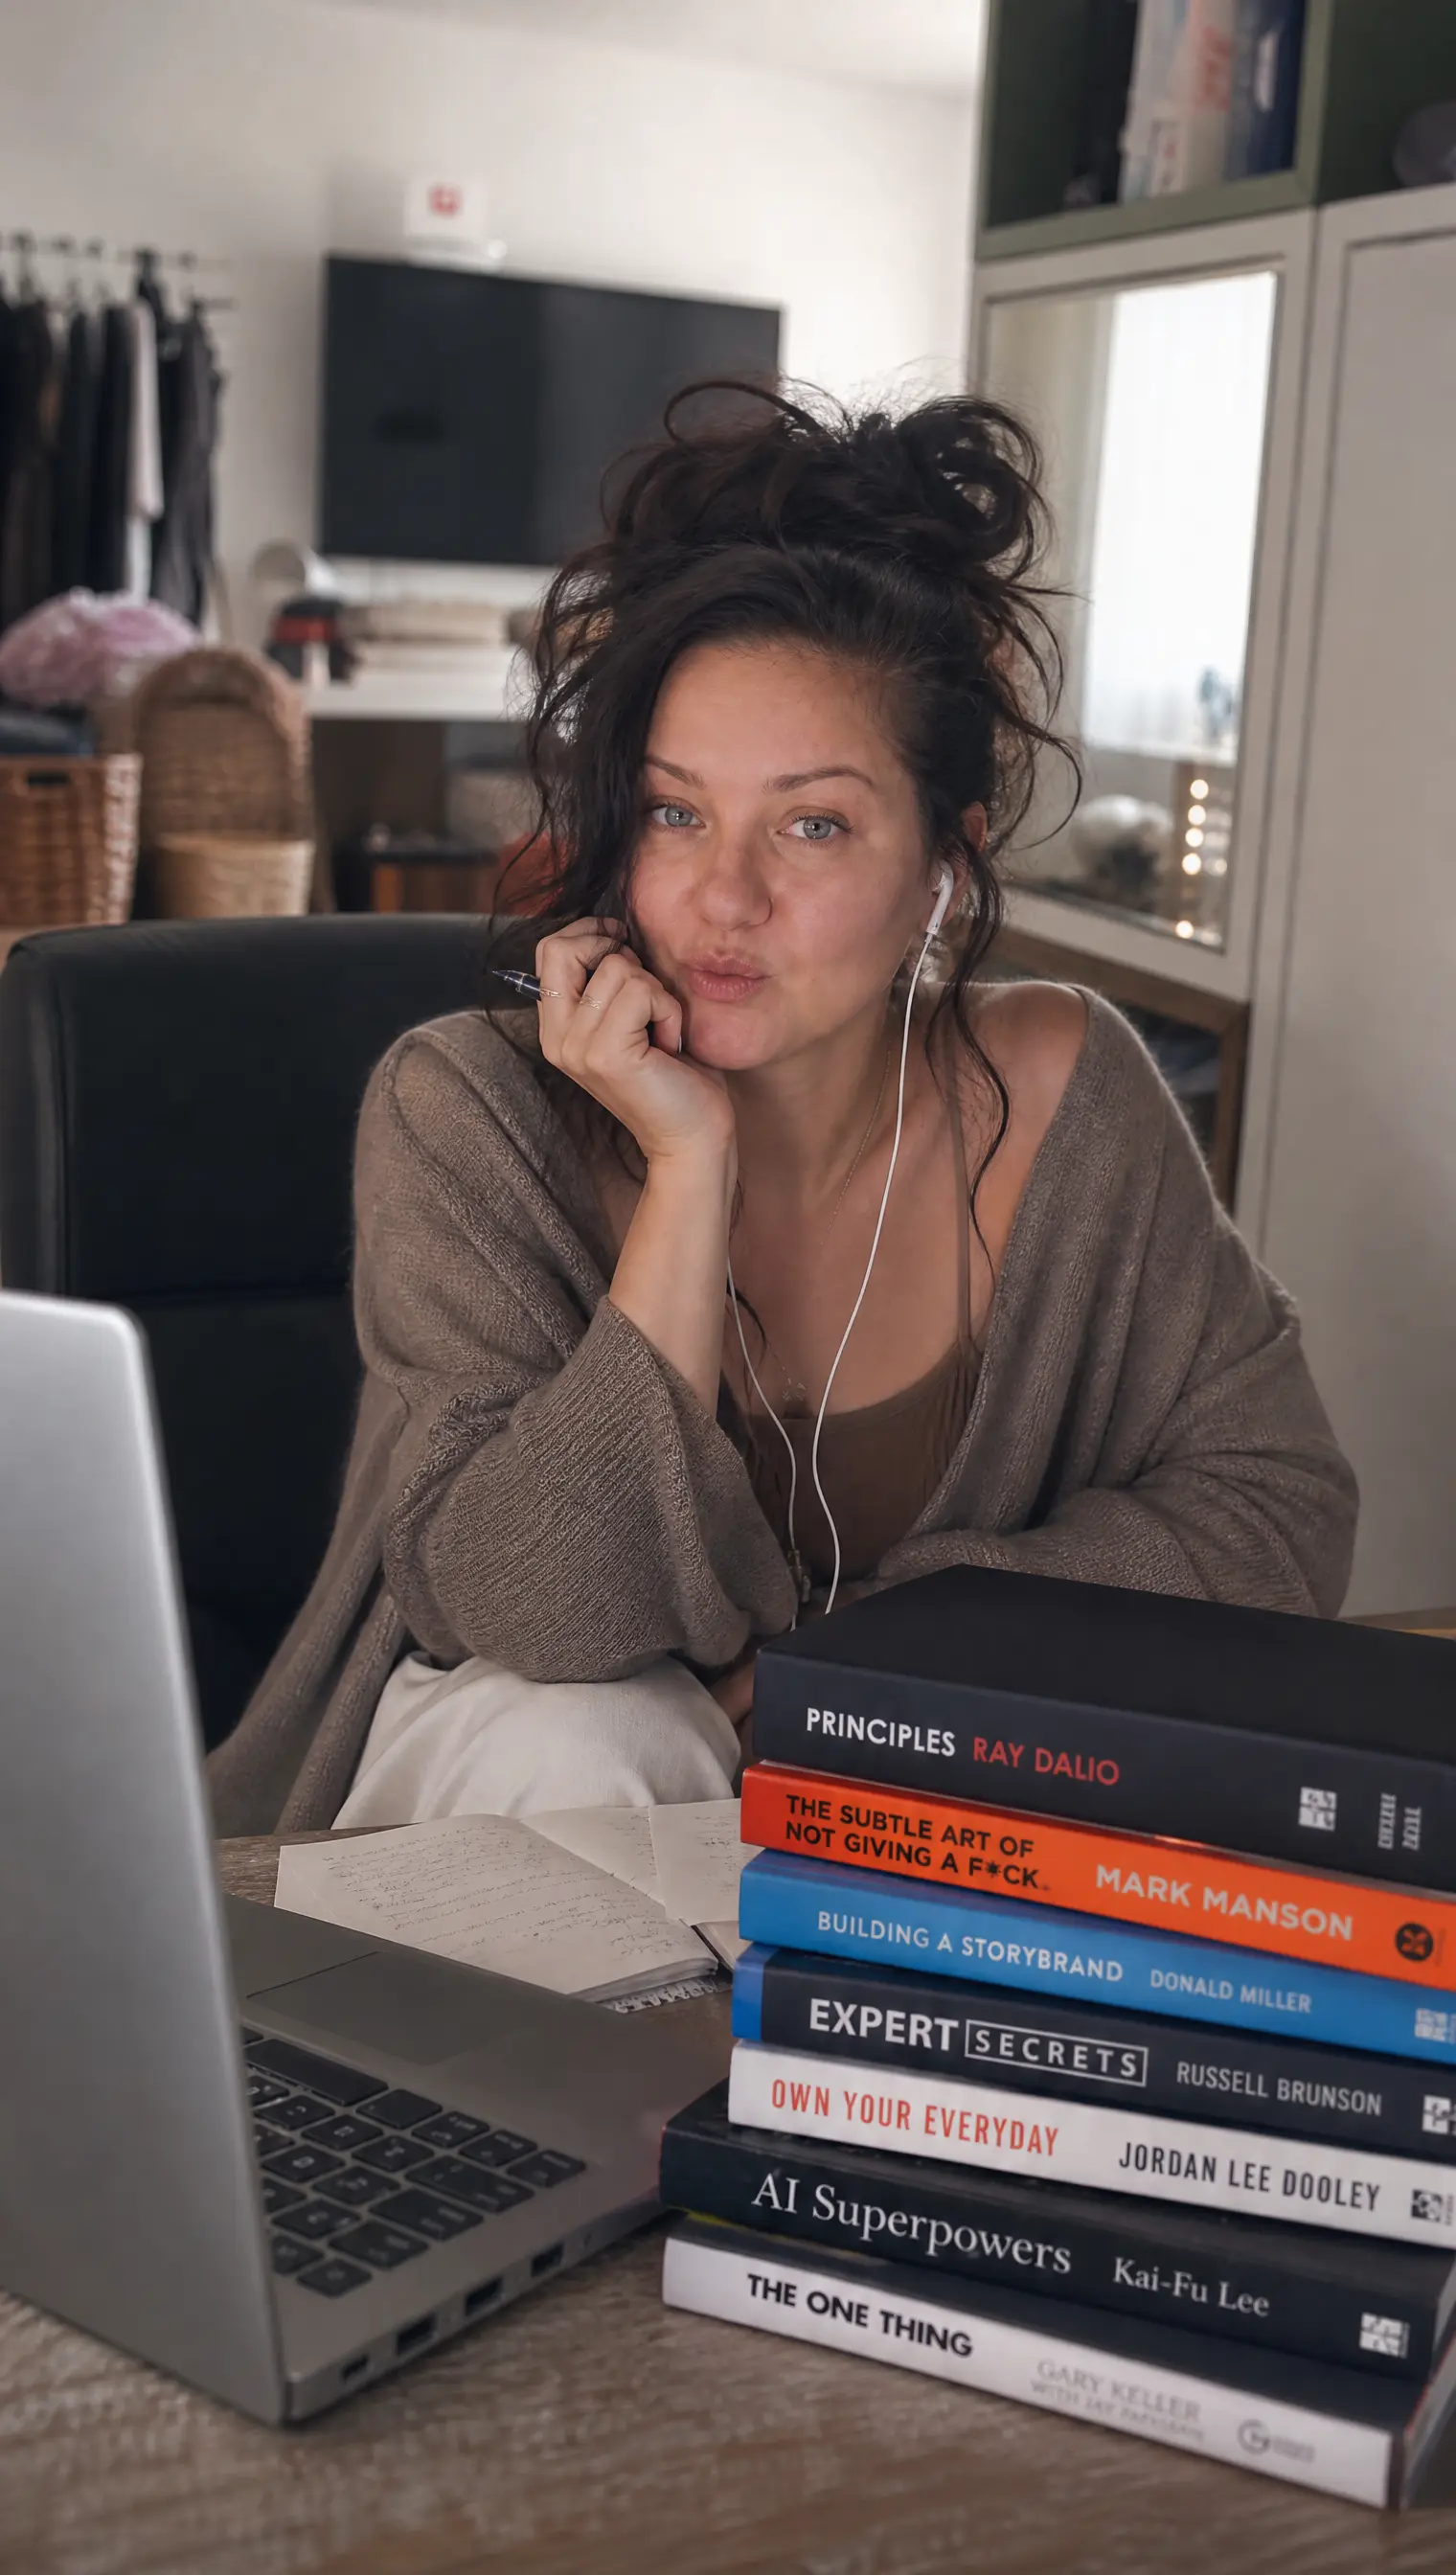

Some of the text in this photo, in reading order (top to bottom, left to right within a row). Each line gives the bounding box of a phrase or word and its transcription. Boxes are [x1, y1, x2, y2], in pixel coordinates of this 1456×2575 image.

[807, 1707, 1120, 1786] PRINCIPLES RAY DALIO
[785, 1793, 1035, 1858] THE SUBTLE ART OF
[786, 1821, 835, 1848] NOT
[844, 1834, 931, 1866] GIVING
[941, 1851, 959, 1874] A
[1096, 1864, 1354, 1942] MARK MANSON
[818, 1910, 1124, 1982] BUILDING A STORYBRAND
[1150, 1969, 1312, 2014] DONALD MILLER
[809, 1997, 1137, 2079] EXPERT SECRETS
[771, 2079, 1059, 2157] OWN YOUR EVERYDAY
[1176, 2061, 1383, 2117] RUSSELL BRUNSON
[1119, 2142, 1381, 2212] JORDAN LEE DOOLEY
[751, 2173, 1073, 2274] AI Superpowers
[747, 2273, 974, 2359] THE ONE THING
[1112, 2257, 1270, 2317] Kai-Fu Lee
[1036, 2359, 1202, 2423] GARY KELLER
